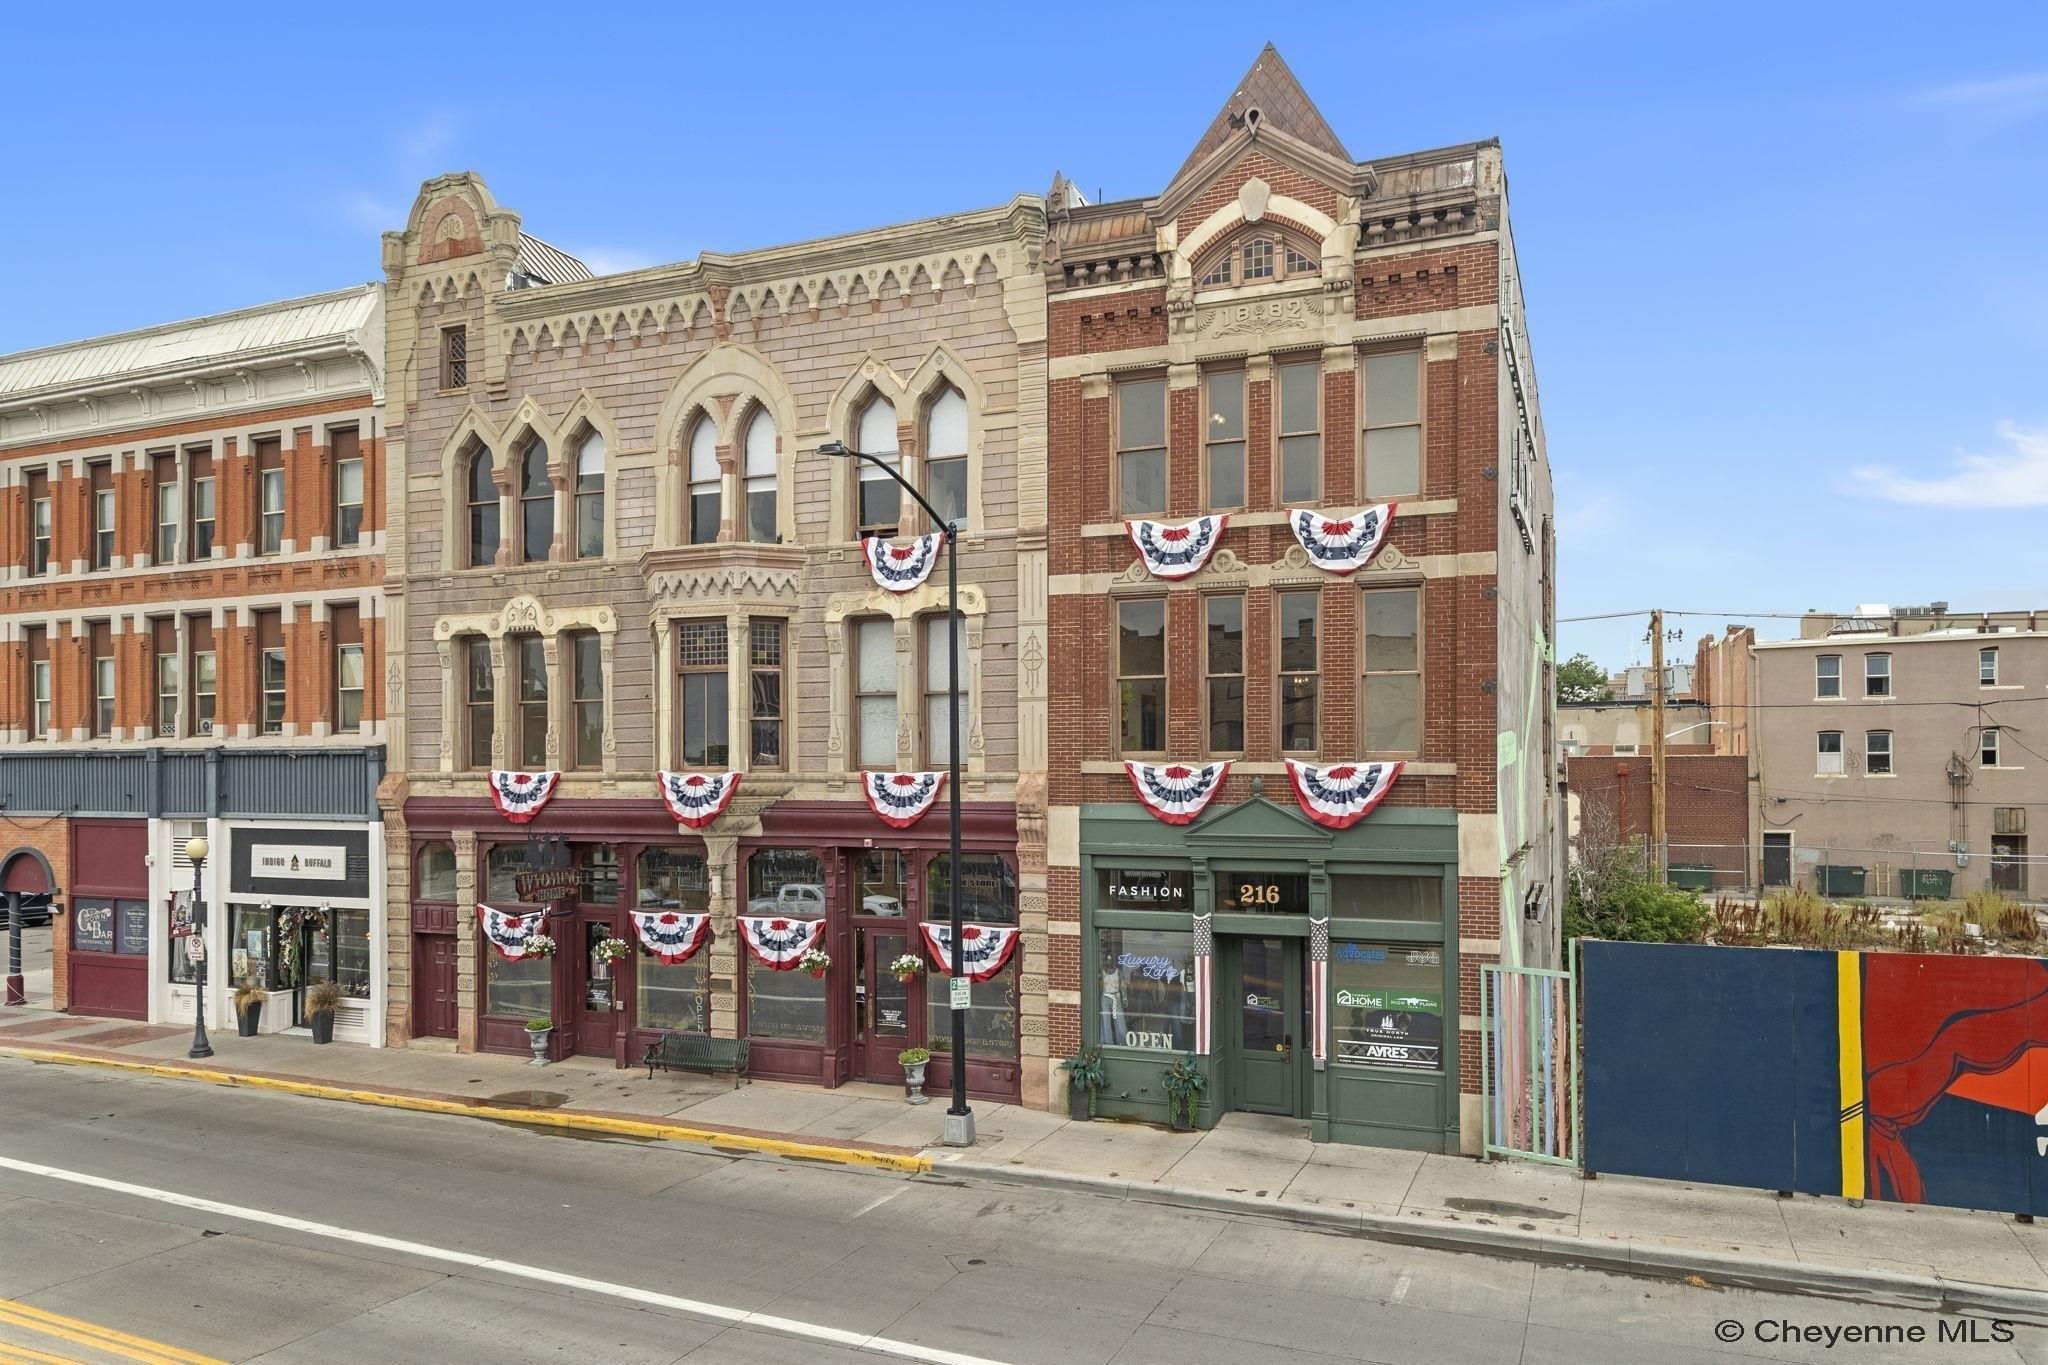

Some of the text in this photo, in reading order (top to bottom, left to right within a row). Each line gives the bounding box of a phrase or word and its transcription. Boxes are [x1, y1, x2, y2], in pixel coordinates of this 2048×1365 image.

[262, 856, 332, 868] INDIGO BUFFALO
[521, 868, 580, 893] WYOMING
[538, 887, 566, 901] HOME
[1109, 885, 1183, 898] FASHION
[1240, 884, 1280, 904] 216
[92, 921, 113, 939] BAR
[1117, 952, 1172, 969] Luxury
[1336, 947, 1386, 960] Advocates
[1142, 966, 1180, 980] Lane
[952, 980, 957, 989] 2
[1351, 997, 1383, 1007] HOME
[695, 997, 704, 1033] OPEN
[1125, 1030, 1173, 1050] OPEN
[1366, 1045, 1409, 1059] AYRES
